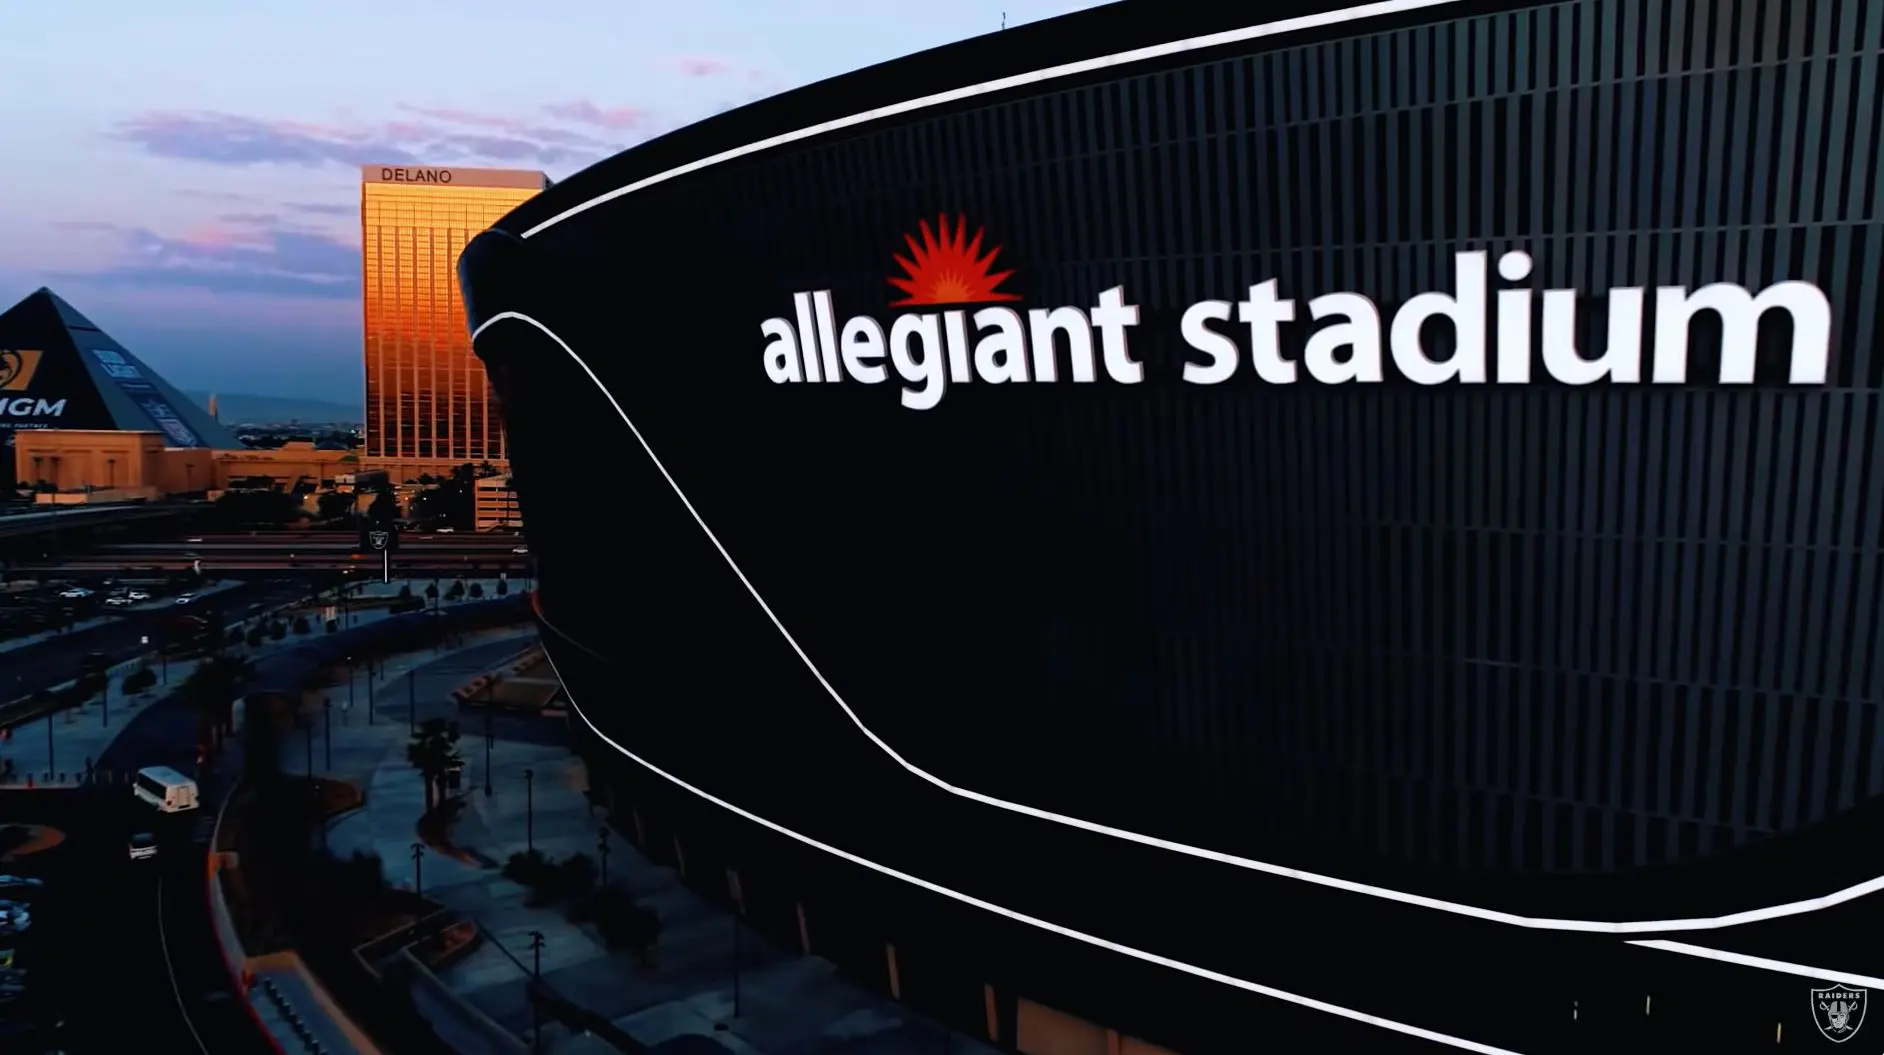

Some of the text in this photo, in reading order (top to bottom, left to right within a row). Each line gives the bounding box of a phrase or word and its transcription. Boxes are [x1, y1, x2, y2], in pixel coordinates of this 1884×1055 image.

[381, 167, 452, 184] DELANO
[761, 250, 1832, 411] allegiant stadium
[0, 397, 68, 417] GM
